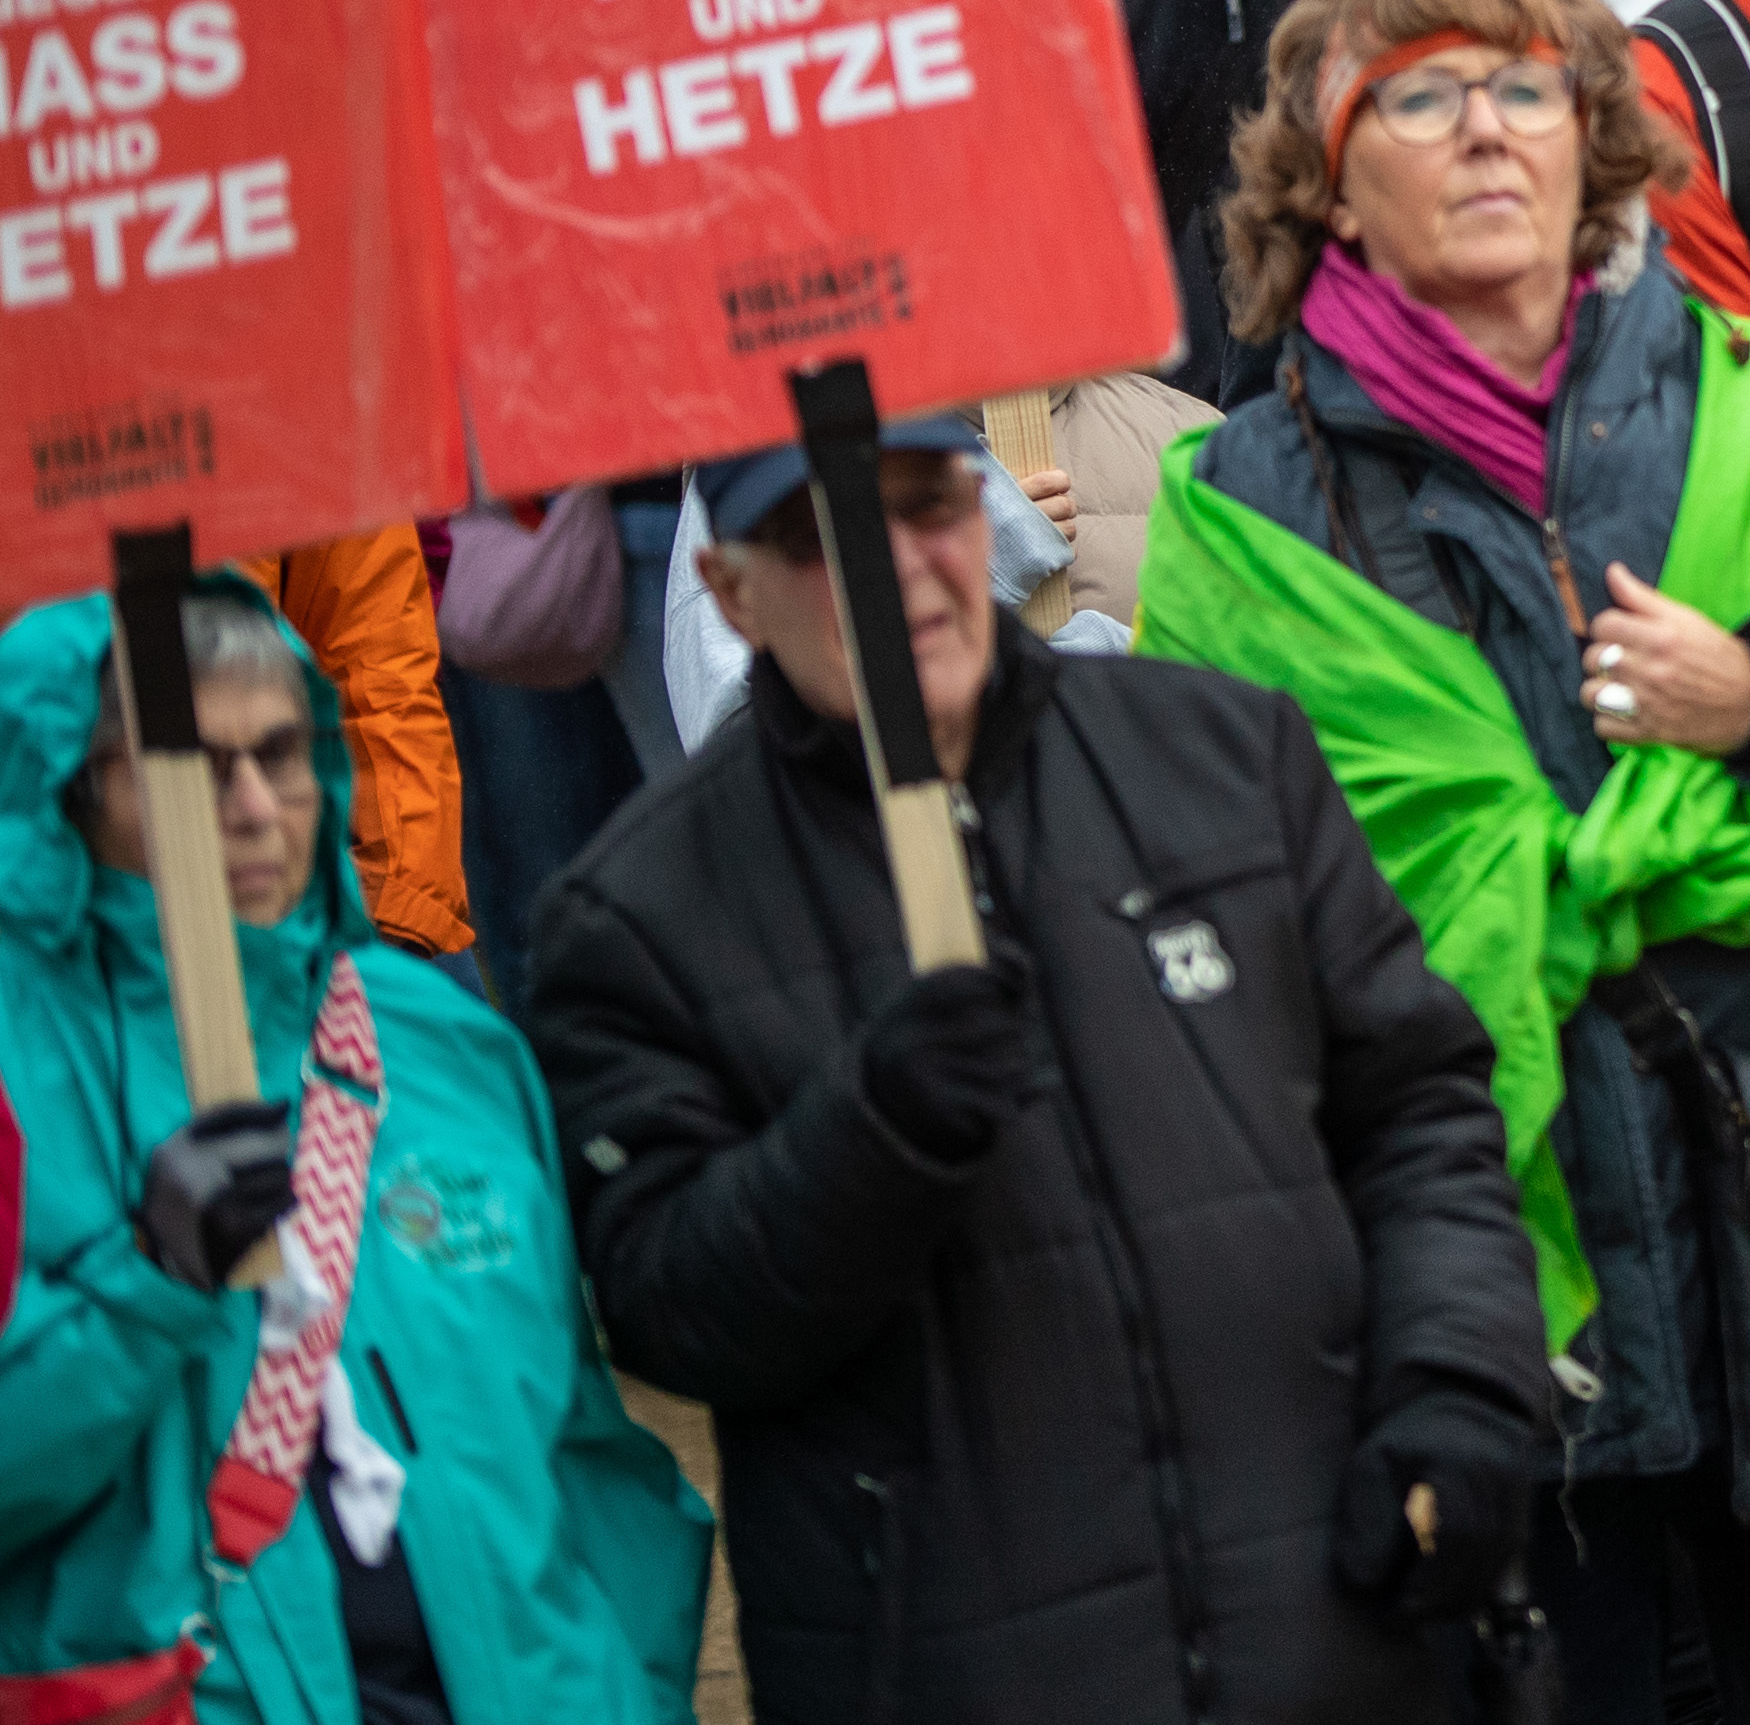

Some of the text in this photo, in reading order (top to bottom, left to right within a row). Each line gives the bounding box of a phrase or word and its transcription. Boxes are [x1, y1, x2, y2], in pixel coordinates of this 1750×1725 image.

[29, 120, 160, 194] UND
[572, 5, 976, 176] HETZE
[0, 155, 299, 312] ETZE
